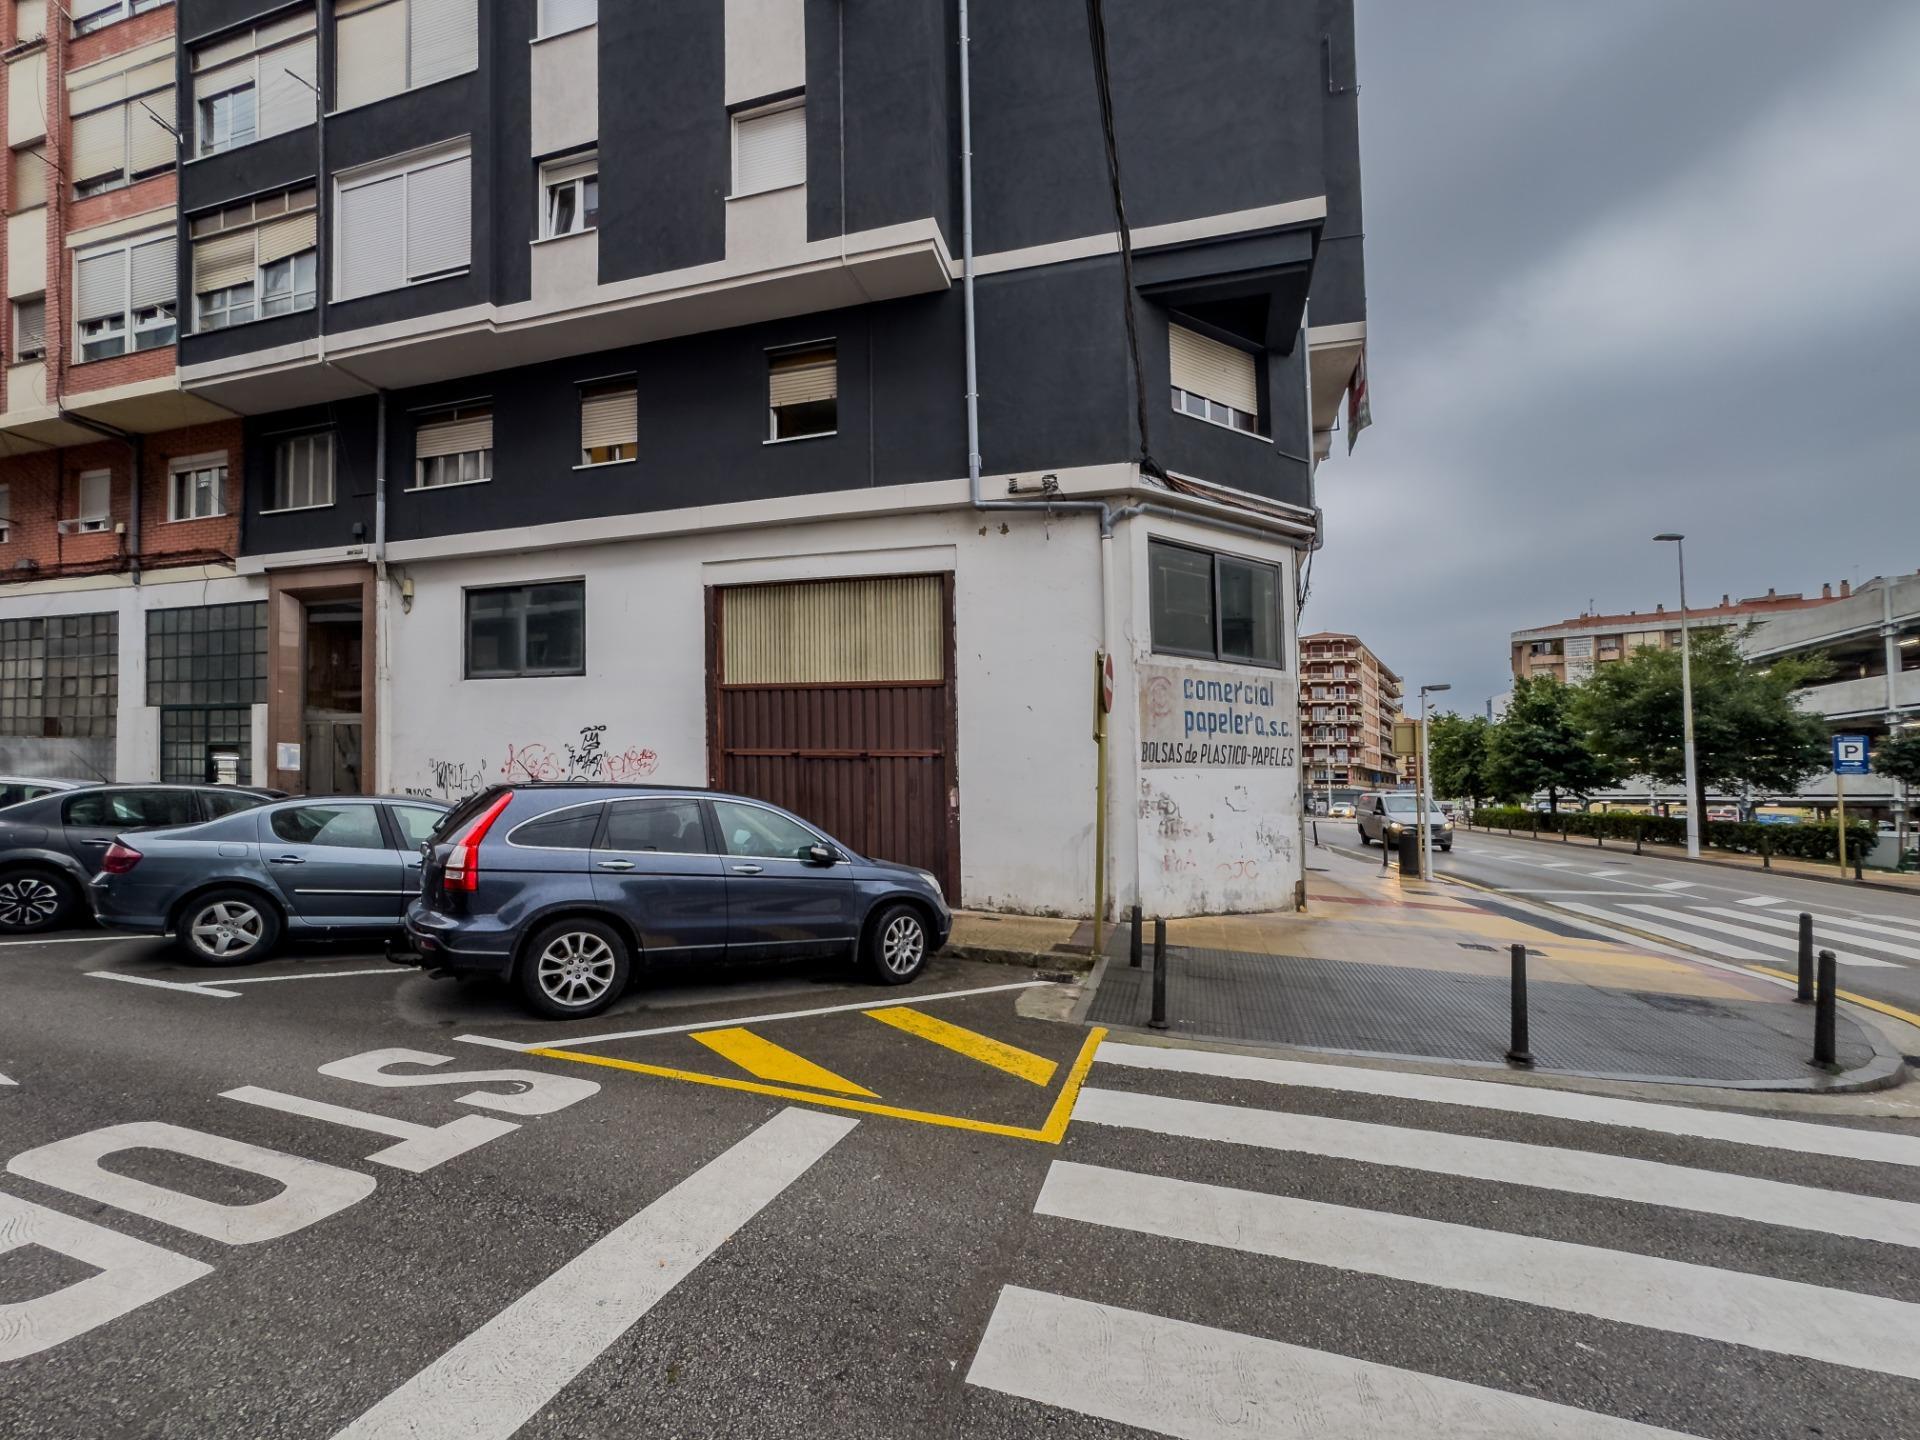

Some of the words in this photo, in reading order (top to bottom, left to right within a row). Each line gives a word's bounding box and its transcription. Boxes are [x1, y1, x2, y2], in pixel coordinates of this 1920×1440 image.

[1184, 678, 1274, 706] comercial
[1141, 741, 1184, 763] BOLSAS
[1184, 743, 1198, 764] de
[1844, 745, 1858, 758] P
